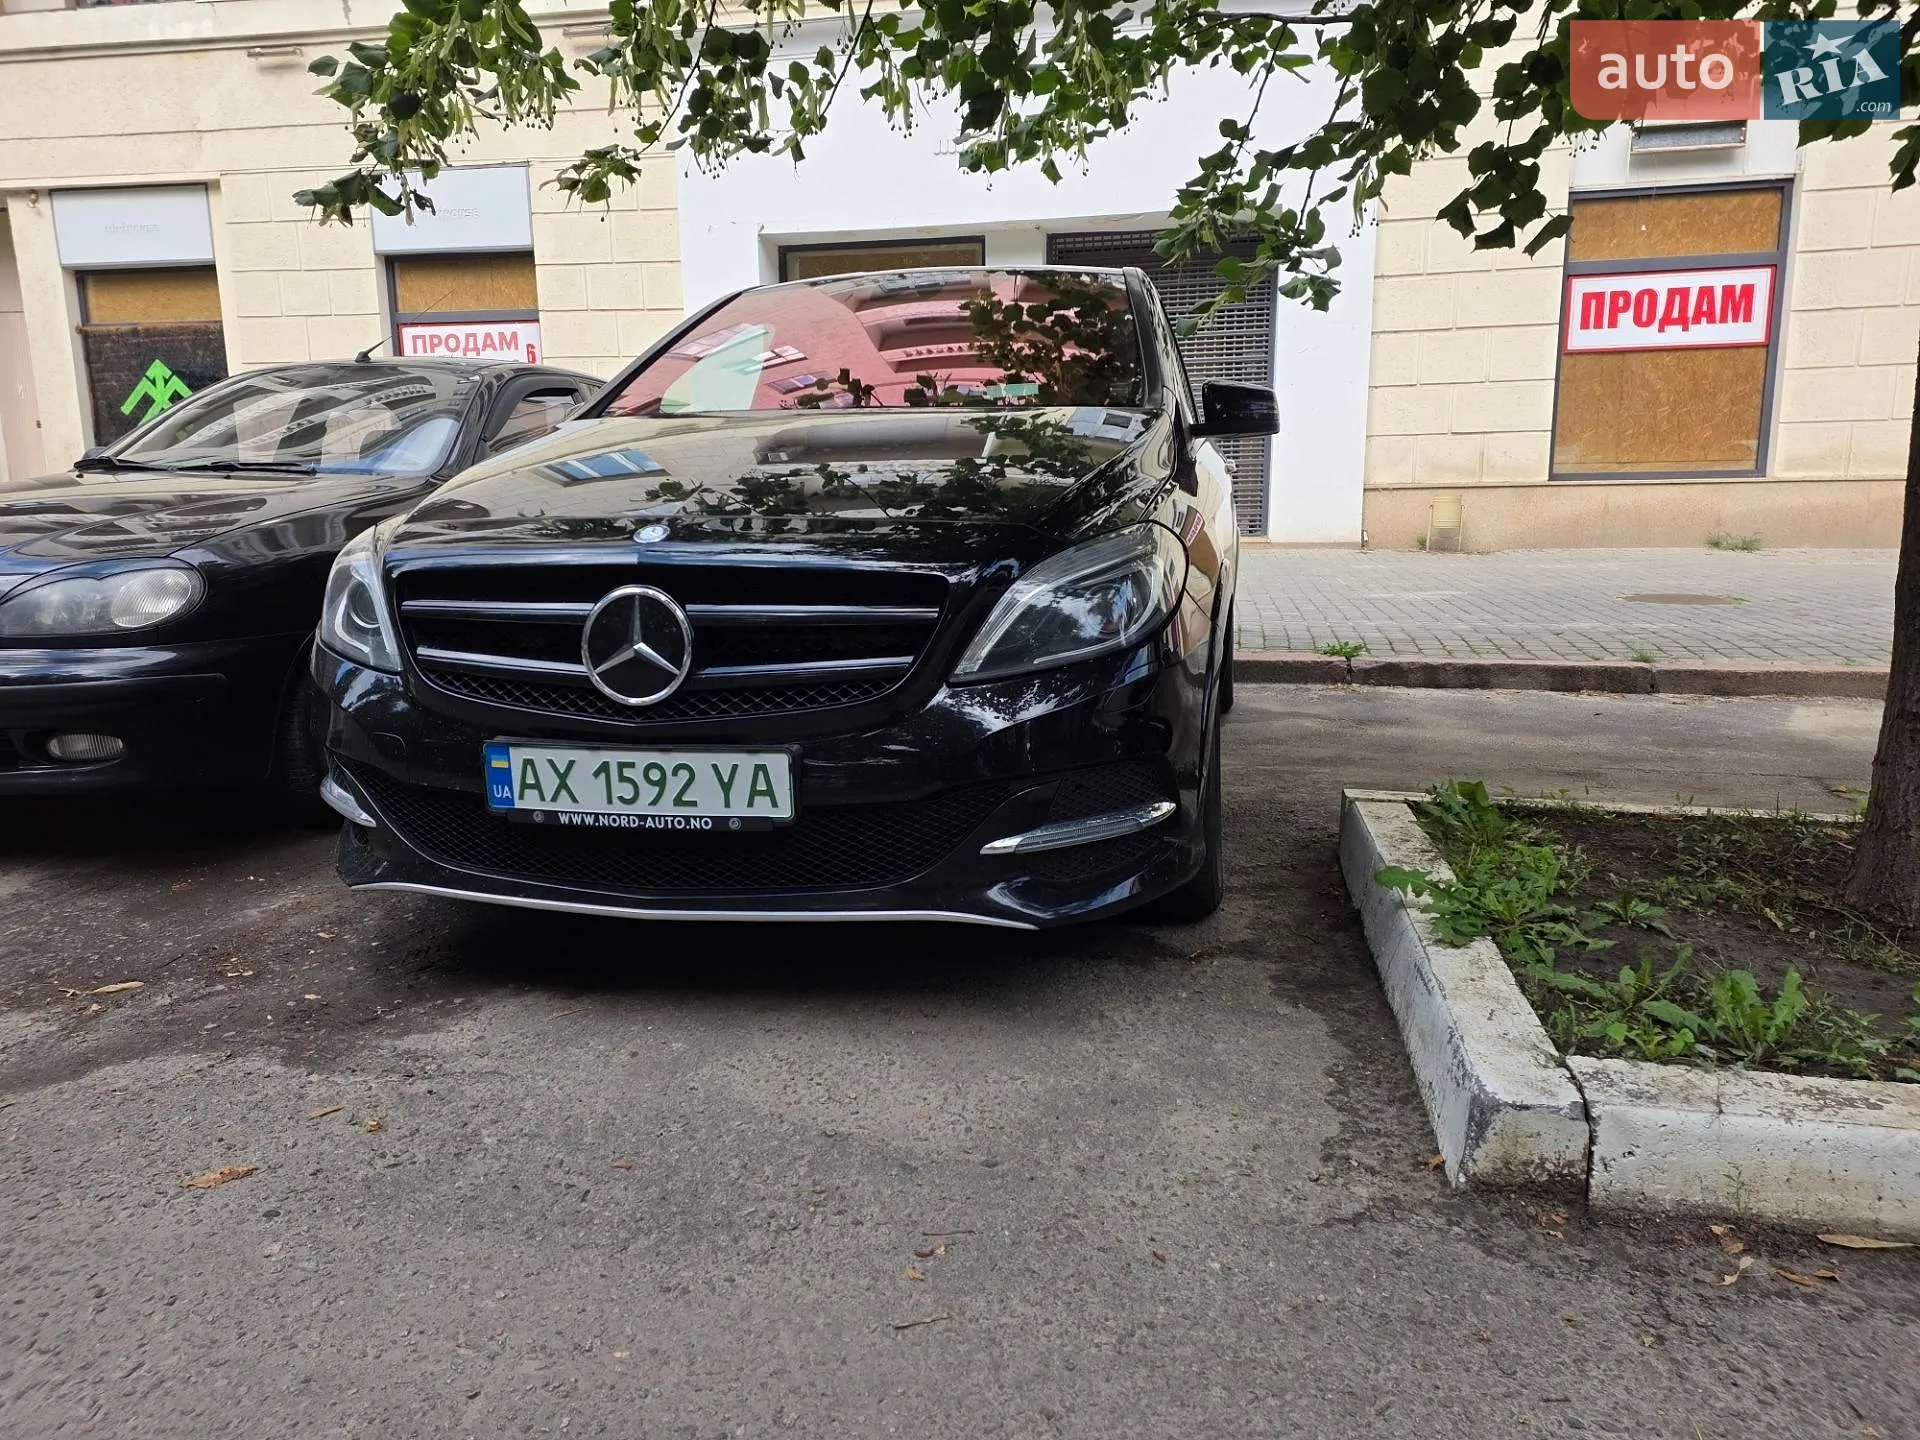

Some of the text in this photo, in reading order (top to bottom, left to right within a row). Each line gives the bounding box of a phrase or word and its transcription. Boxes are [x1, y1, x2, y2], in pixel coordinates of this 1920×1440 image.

[1579, 283, 1755, 333] ПРОДАМ
[411, 331, 519, 356] ПРОДАМ
[493, 784, 512, 799] UA
[518, 758, 779, 809] AX 1592 YA
[558, 812, 712, 830] WWW.NORD-AUTO.NO
